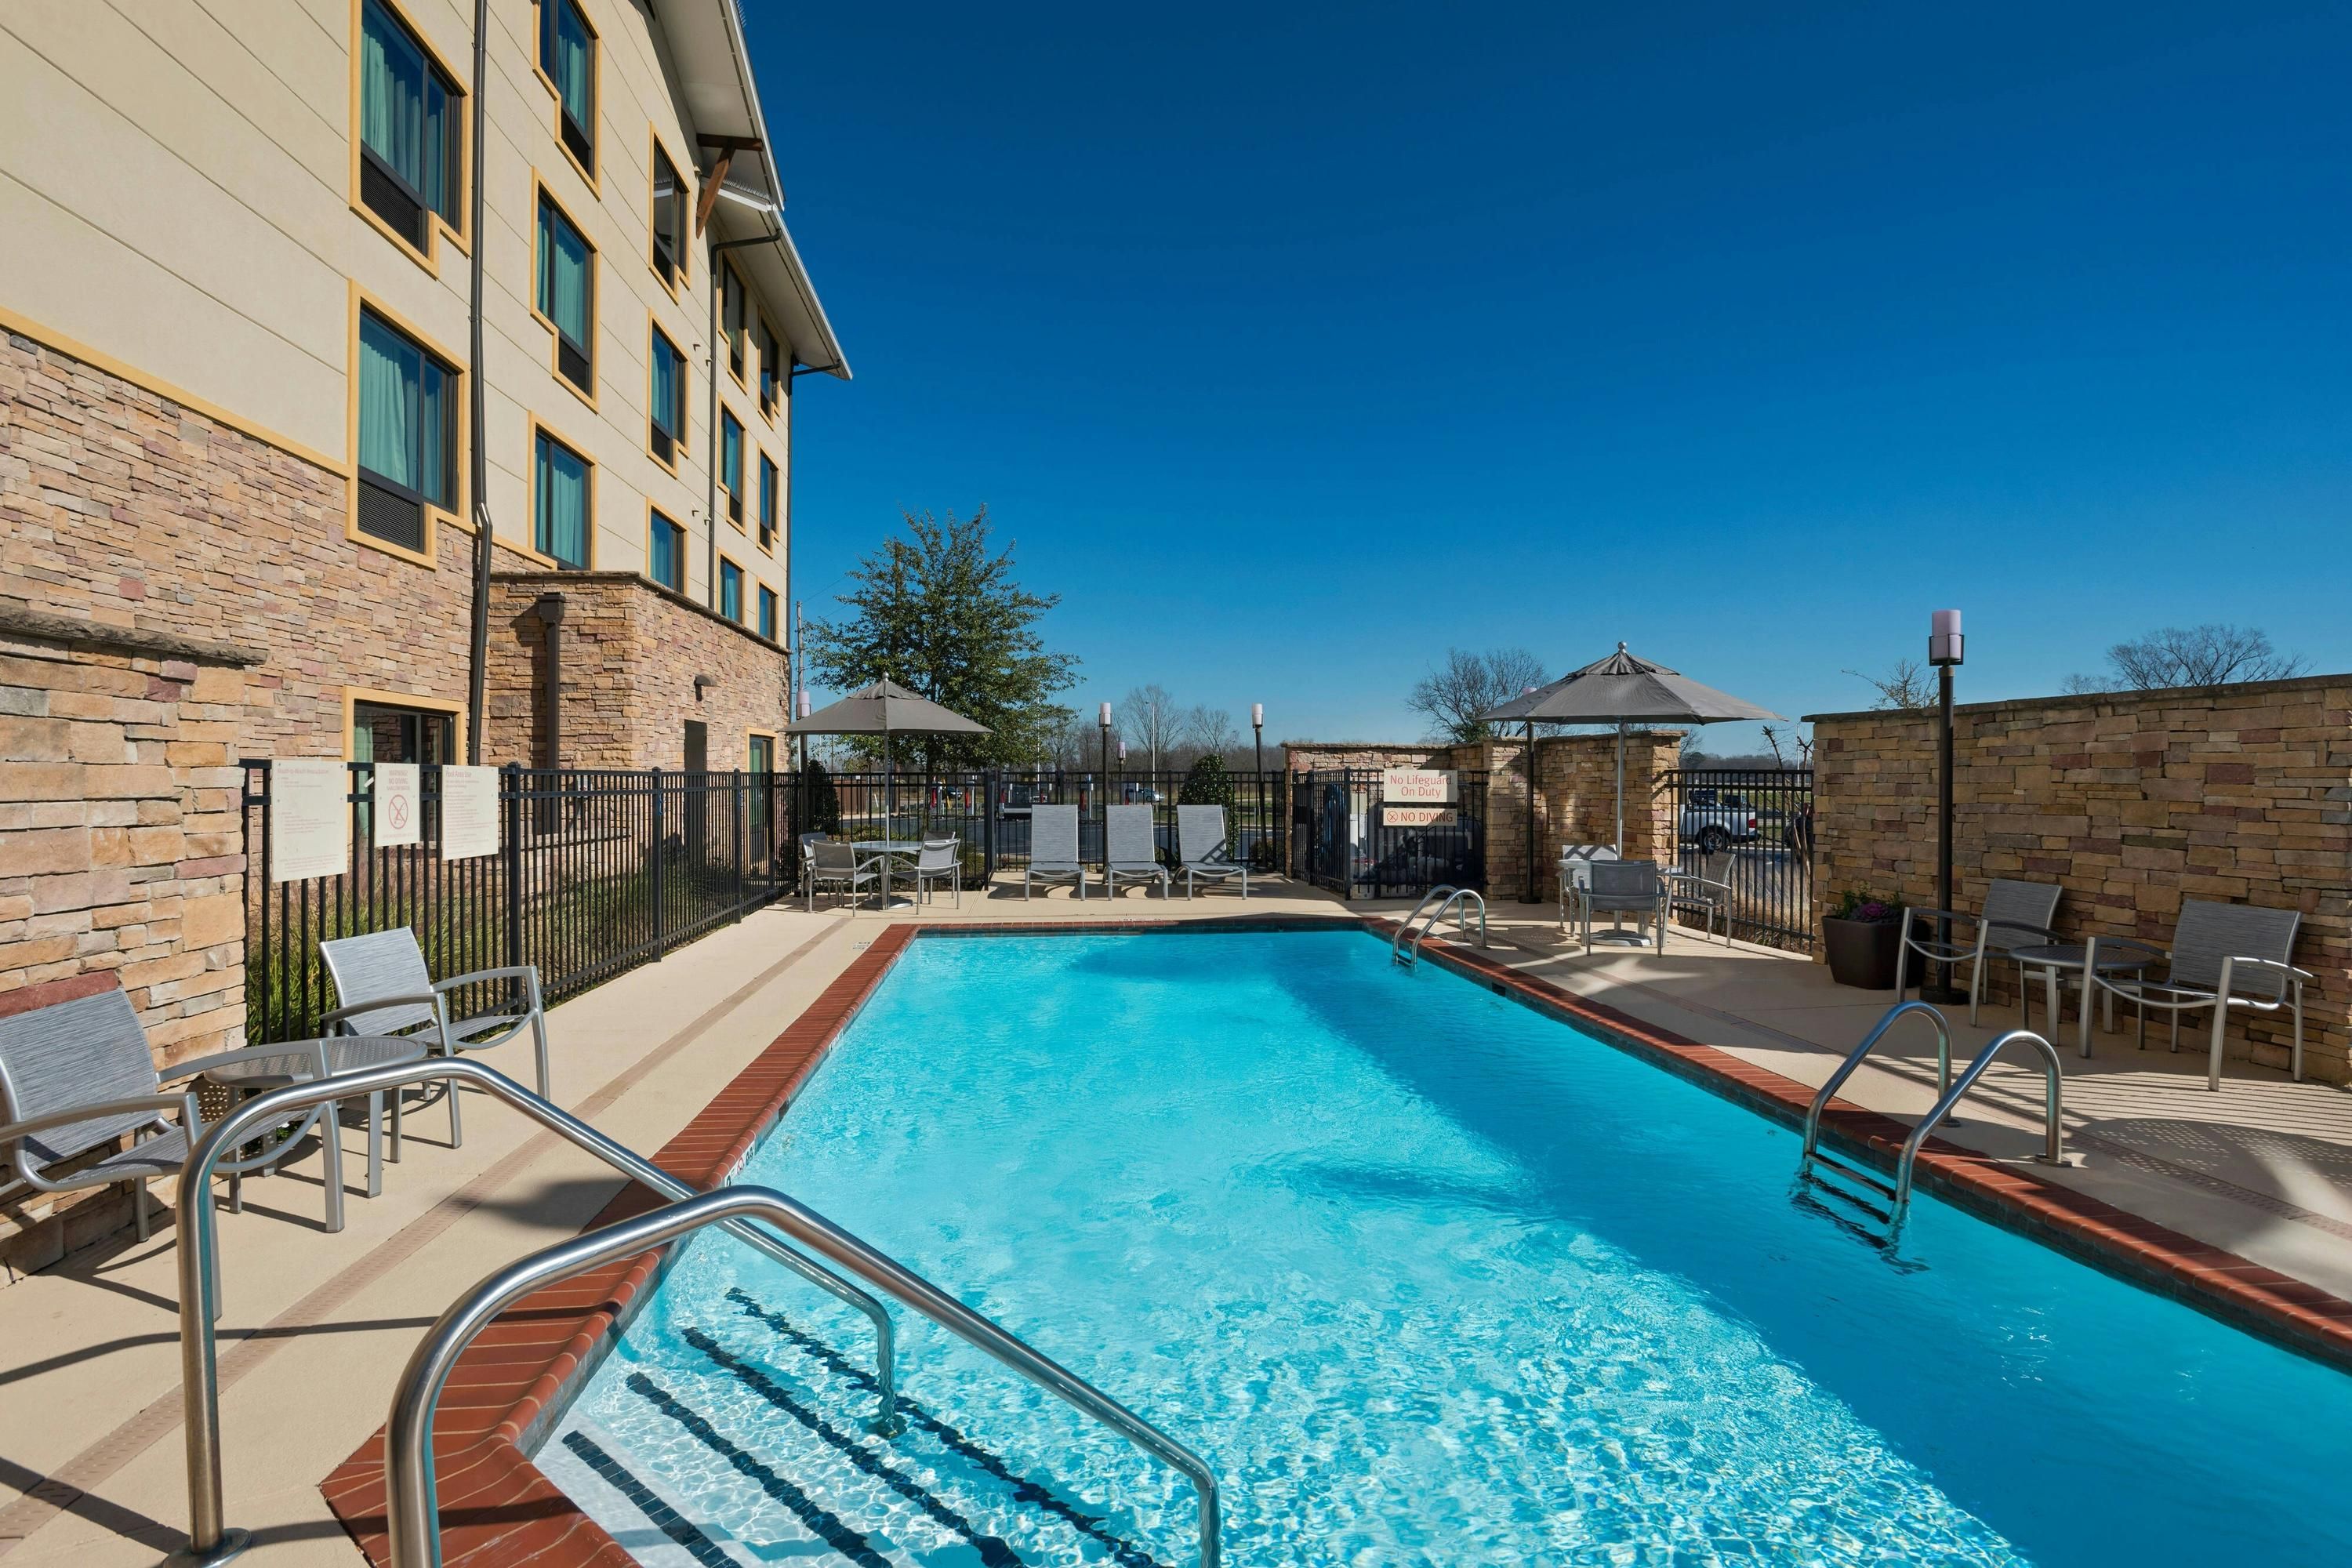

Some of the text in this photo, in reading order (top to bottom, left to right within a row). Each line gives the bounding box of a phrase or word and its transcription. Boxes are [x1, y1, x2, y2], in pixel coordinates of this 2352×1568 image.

[1390, 775, 1452, 787] No Lifeguard
[1401, 786, 1441, 799] On Duty
[1400, 812, 1454, 822] NO DIVING
